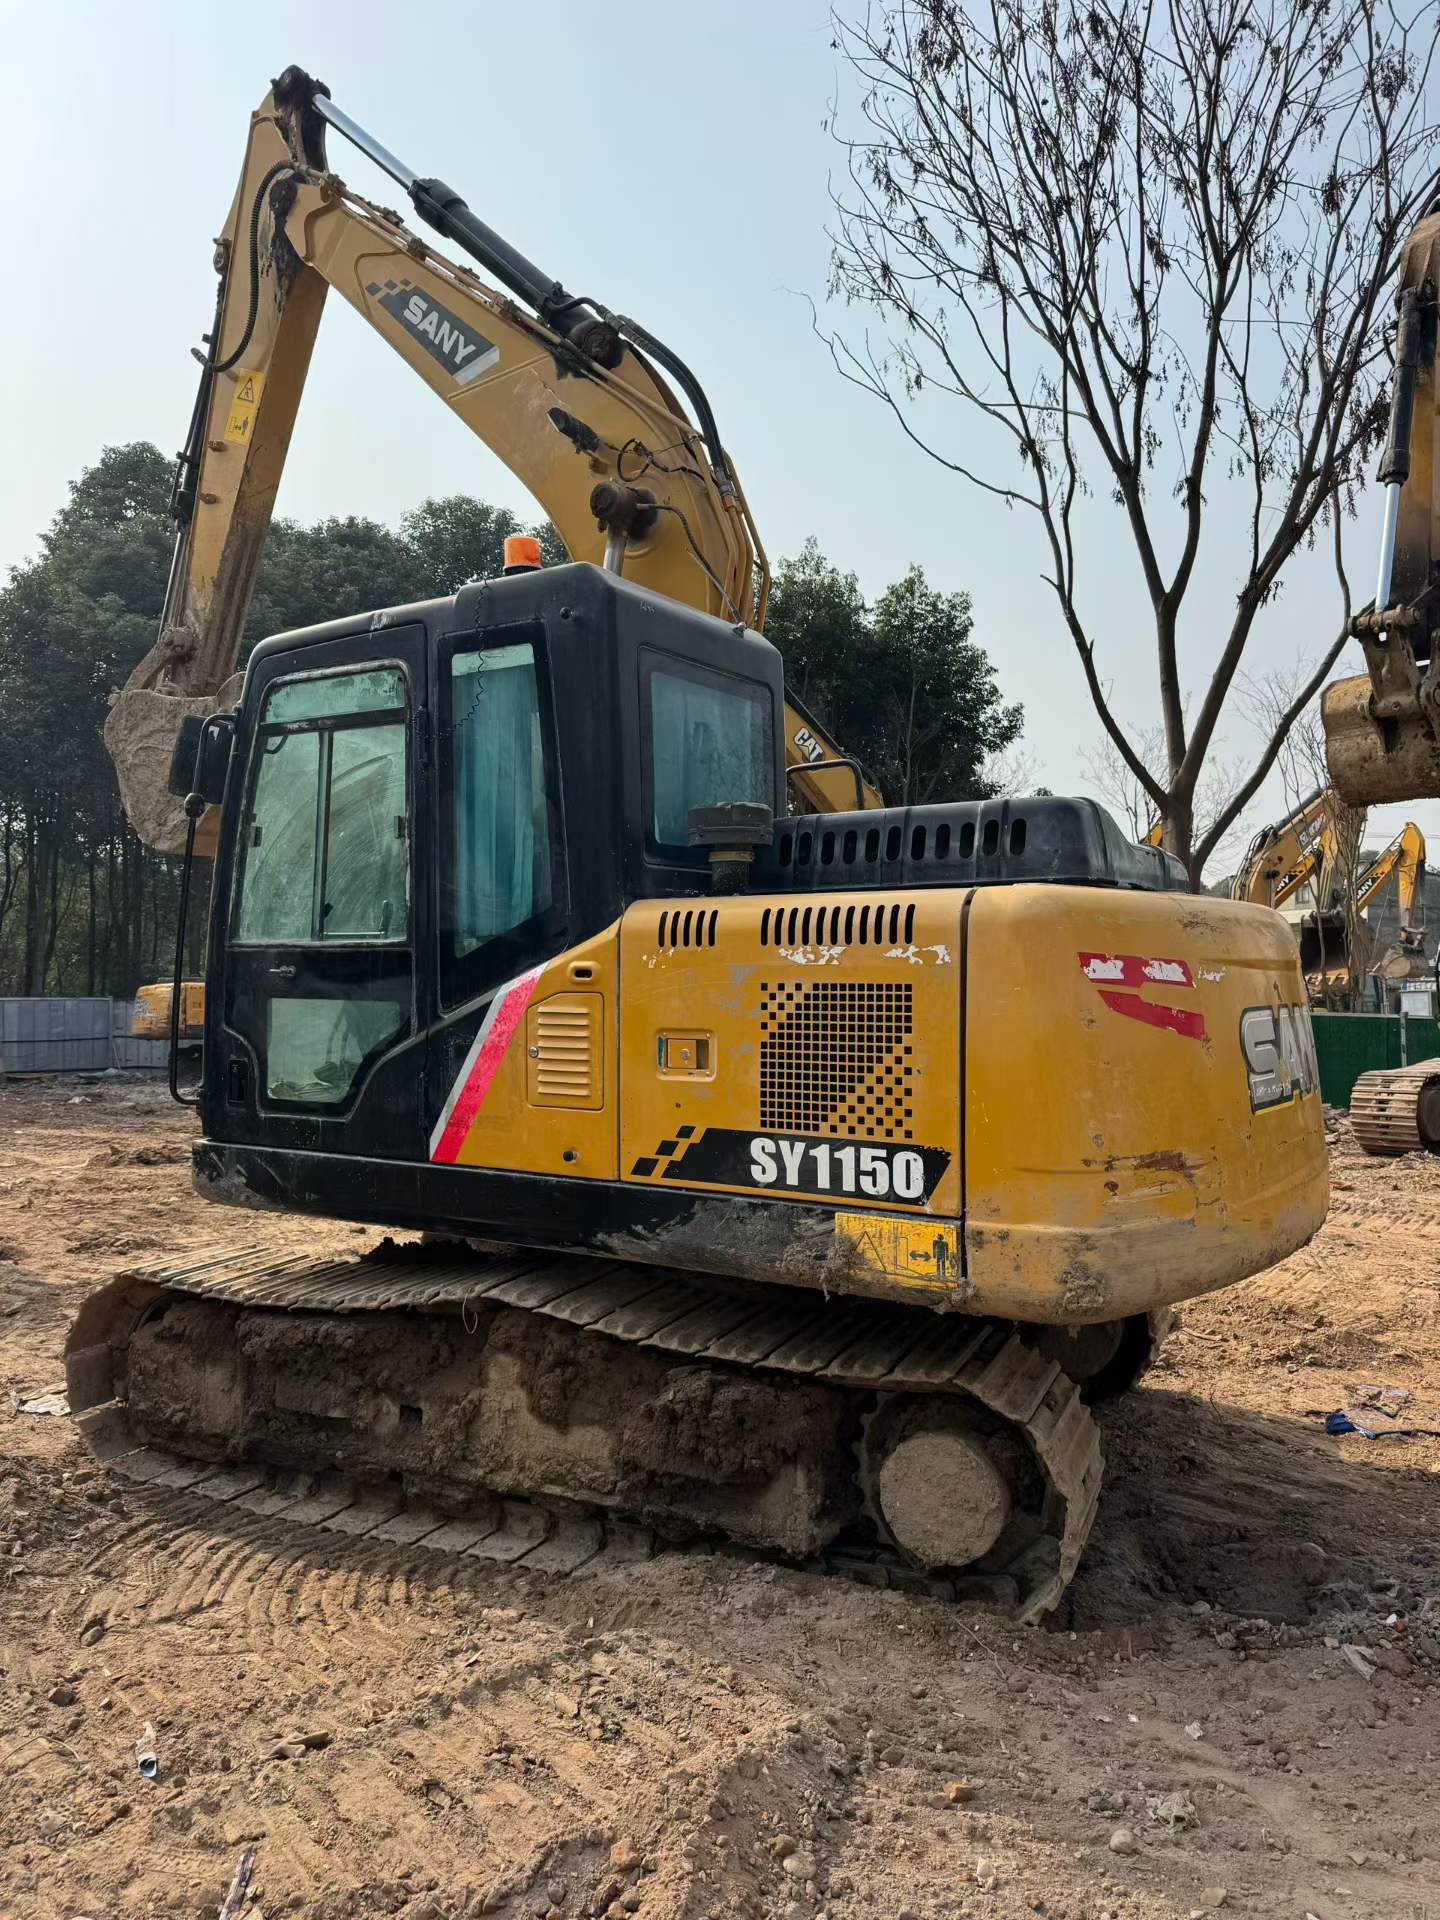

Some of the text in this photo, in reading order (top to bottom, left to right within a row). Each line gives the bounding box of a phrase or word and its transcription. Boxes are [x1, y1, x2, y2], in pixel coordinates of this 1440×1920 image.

[404, 295, 476, 365] SANY
[794, 728, 823, 762] CAT
[1356, 878, 1373, 899] ANY
[1241, 1006, 1319, 1104] SAN
[750, 1138, 924, 1199] SY1150
